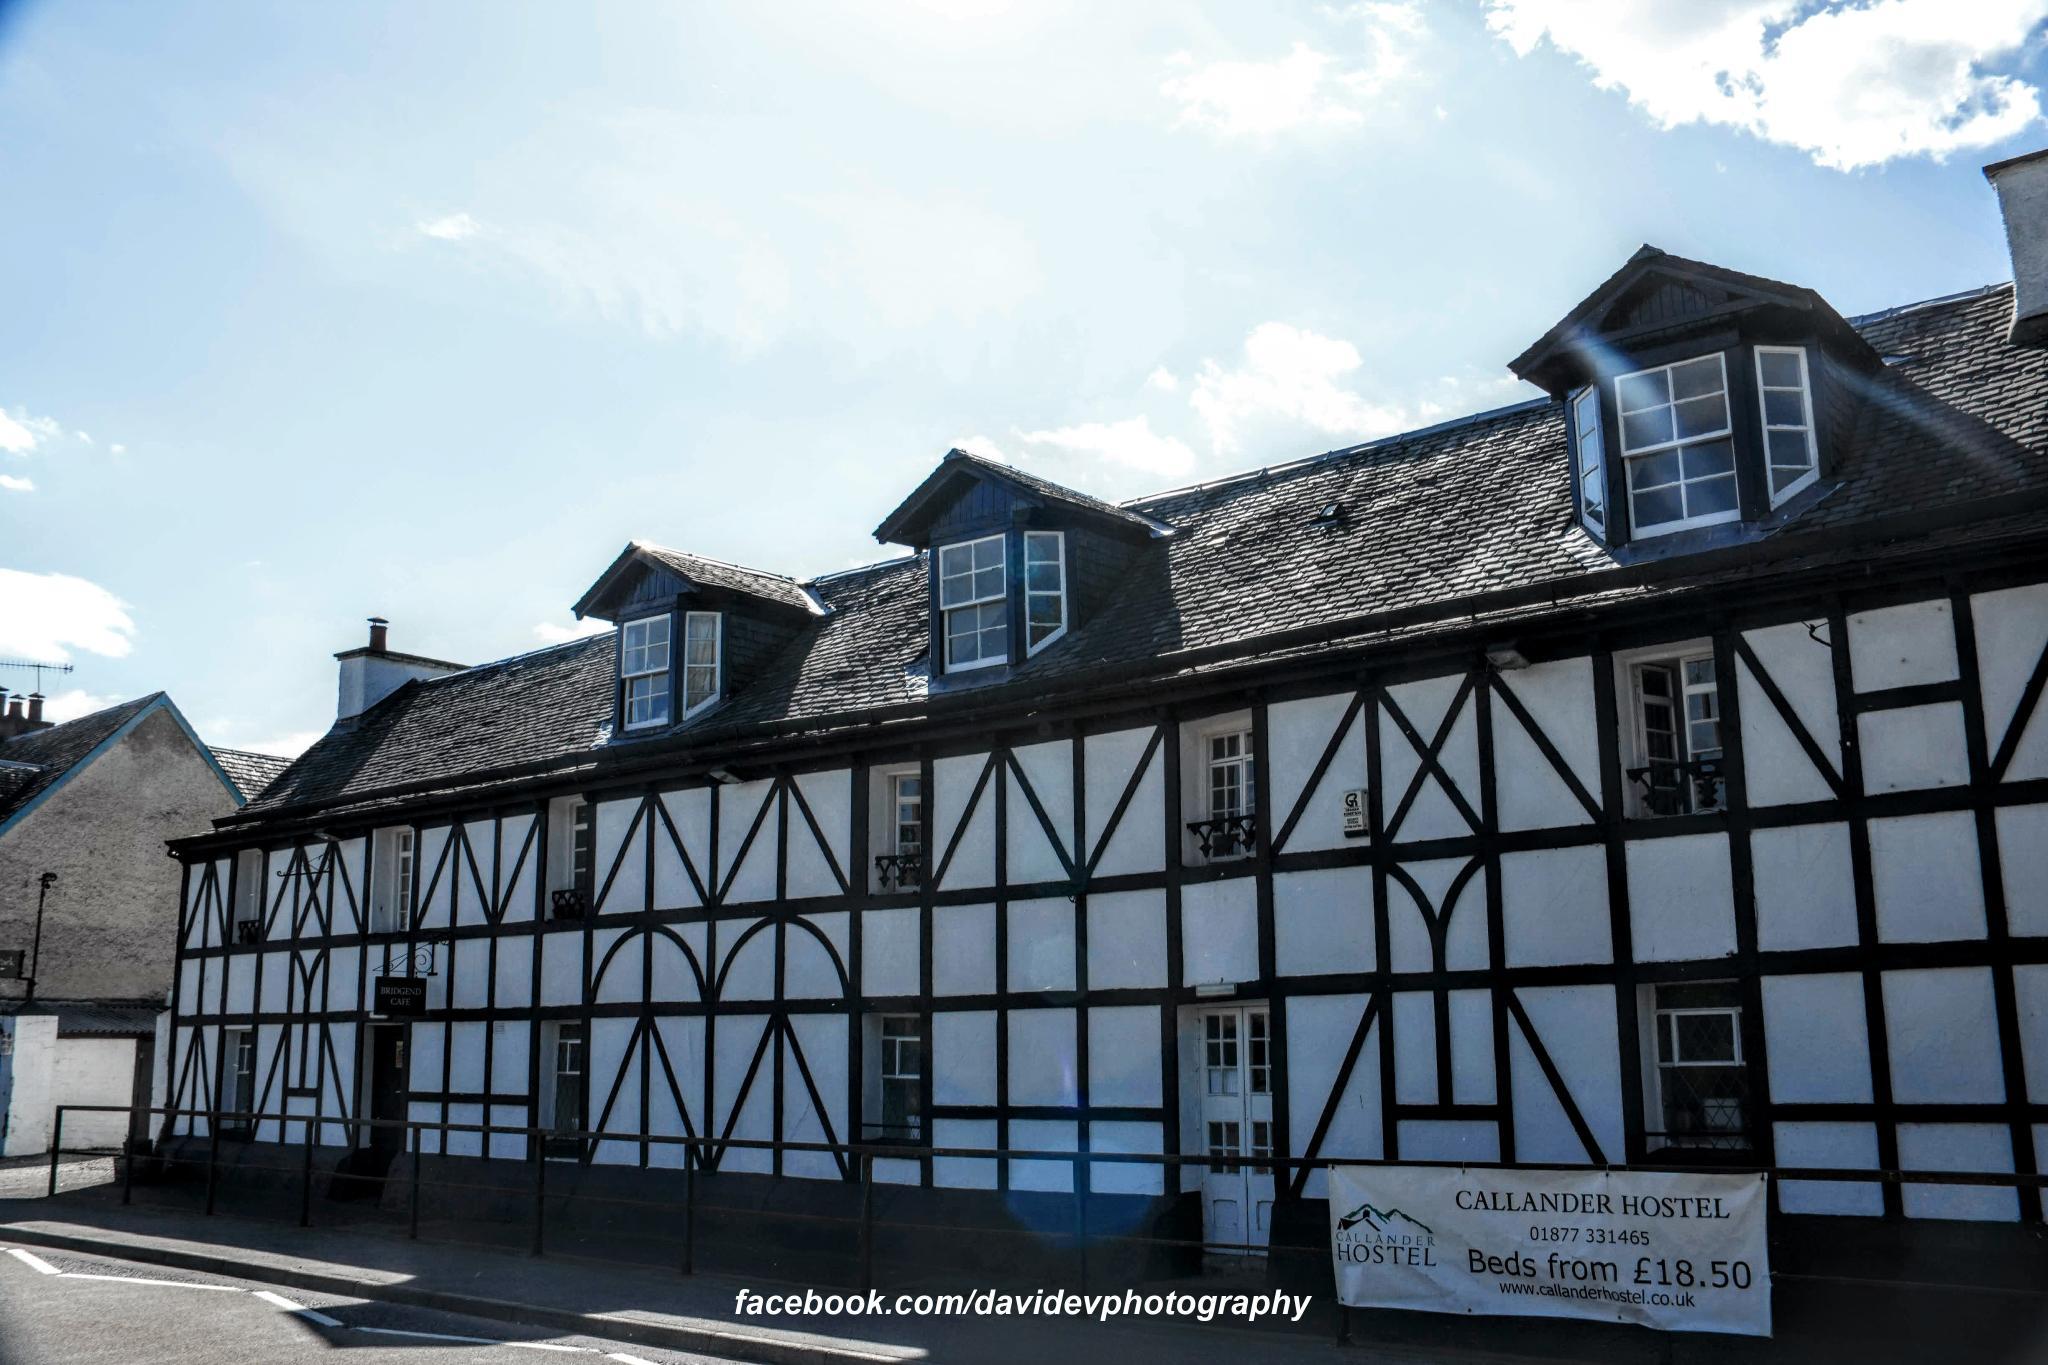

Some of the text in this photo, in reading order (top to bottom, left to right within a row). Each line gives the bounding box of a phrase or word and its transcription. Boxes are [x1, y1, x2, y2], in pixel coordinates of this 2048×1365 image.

[380, 986, 422, 996] BRIDGEND
[1455, 1190, 1730, 1219] CALLANDER HOSTEL
[1336, 1231, 1435, 1247] CALLANDER
[1529, 1226, 1650, 1245] 01877 331465
[1338, 1243, 1437, 1267] HOSTEL
[1469, 1248, 1752, 1290] Beds from £18.50
[1499, 1281, 1695, 1308] www.callanderhostel.co.uk
